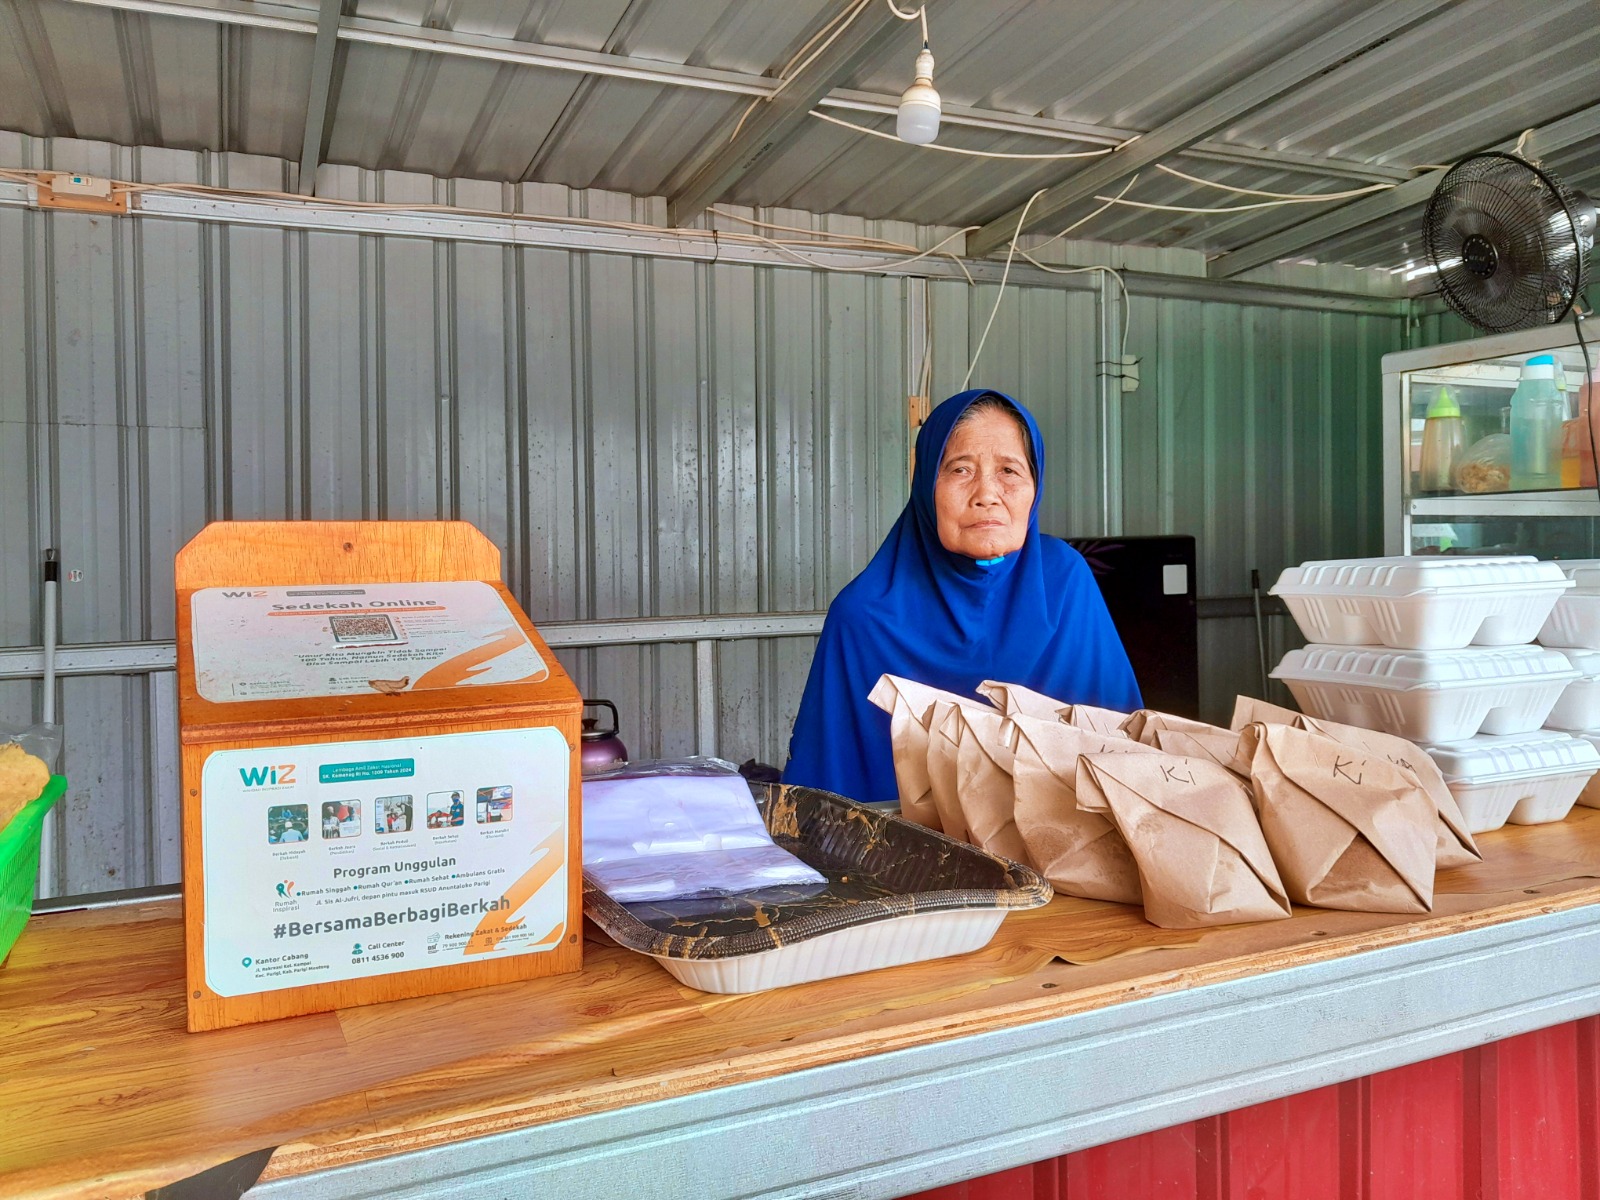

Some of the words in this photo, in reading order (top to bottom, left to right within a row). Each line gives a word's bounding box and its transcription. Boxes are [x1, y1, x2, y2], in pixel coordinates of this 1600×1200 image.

[272, 601, 363, 611] Sedekah
[369, 599, 437, 608] Online
[1160, 758, 1196, 786] Ki
[334, 864, 391, 879] Program
[395, 856, 456, 872] Unggulan
[301, 888, 324, 896] Rumah
[325, 885, 352, 896] Singgah
[358, 882, 380, 890] Rumah
[381, 879, 403, 888] Qur'an
[408, 876, 430, 884] Rumah
[431, 874, 450, 882] Sehat
[456, 871, 486, 879] Ambulans
[361, 893, 381, 902] depan
[381, 891, 398, 899] pintu
[399, 888, 419, 896] masuk
[438, 882, 472, 891] Anuntaloko
[474, 880, 491, 888] Parigi
[272, 904, 300, 913] Inspirasi
[274, 899, 297, 907] Rumah
[273, 896, 510, 939] #BersamaBerbagiBerkah
[444, 931, 474, 940] Rekening
[476, 928, 494, 936] Zakat
[500, 924, 528, 933] Sedekah
[382, 940, 405, 949] Center
[255, 957, 280, 965] Kantor
[282, 953, 309, 962] Cabang
[351, 956, 369, 965] 0811
[372, 953, 390, 962] 4536
[391, 951, 405, 959] 900
